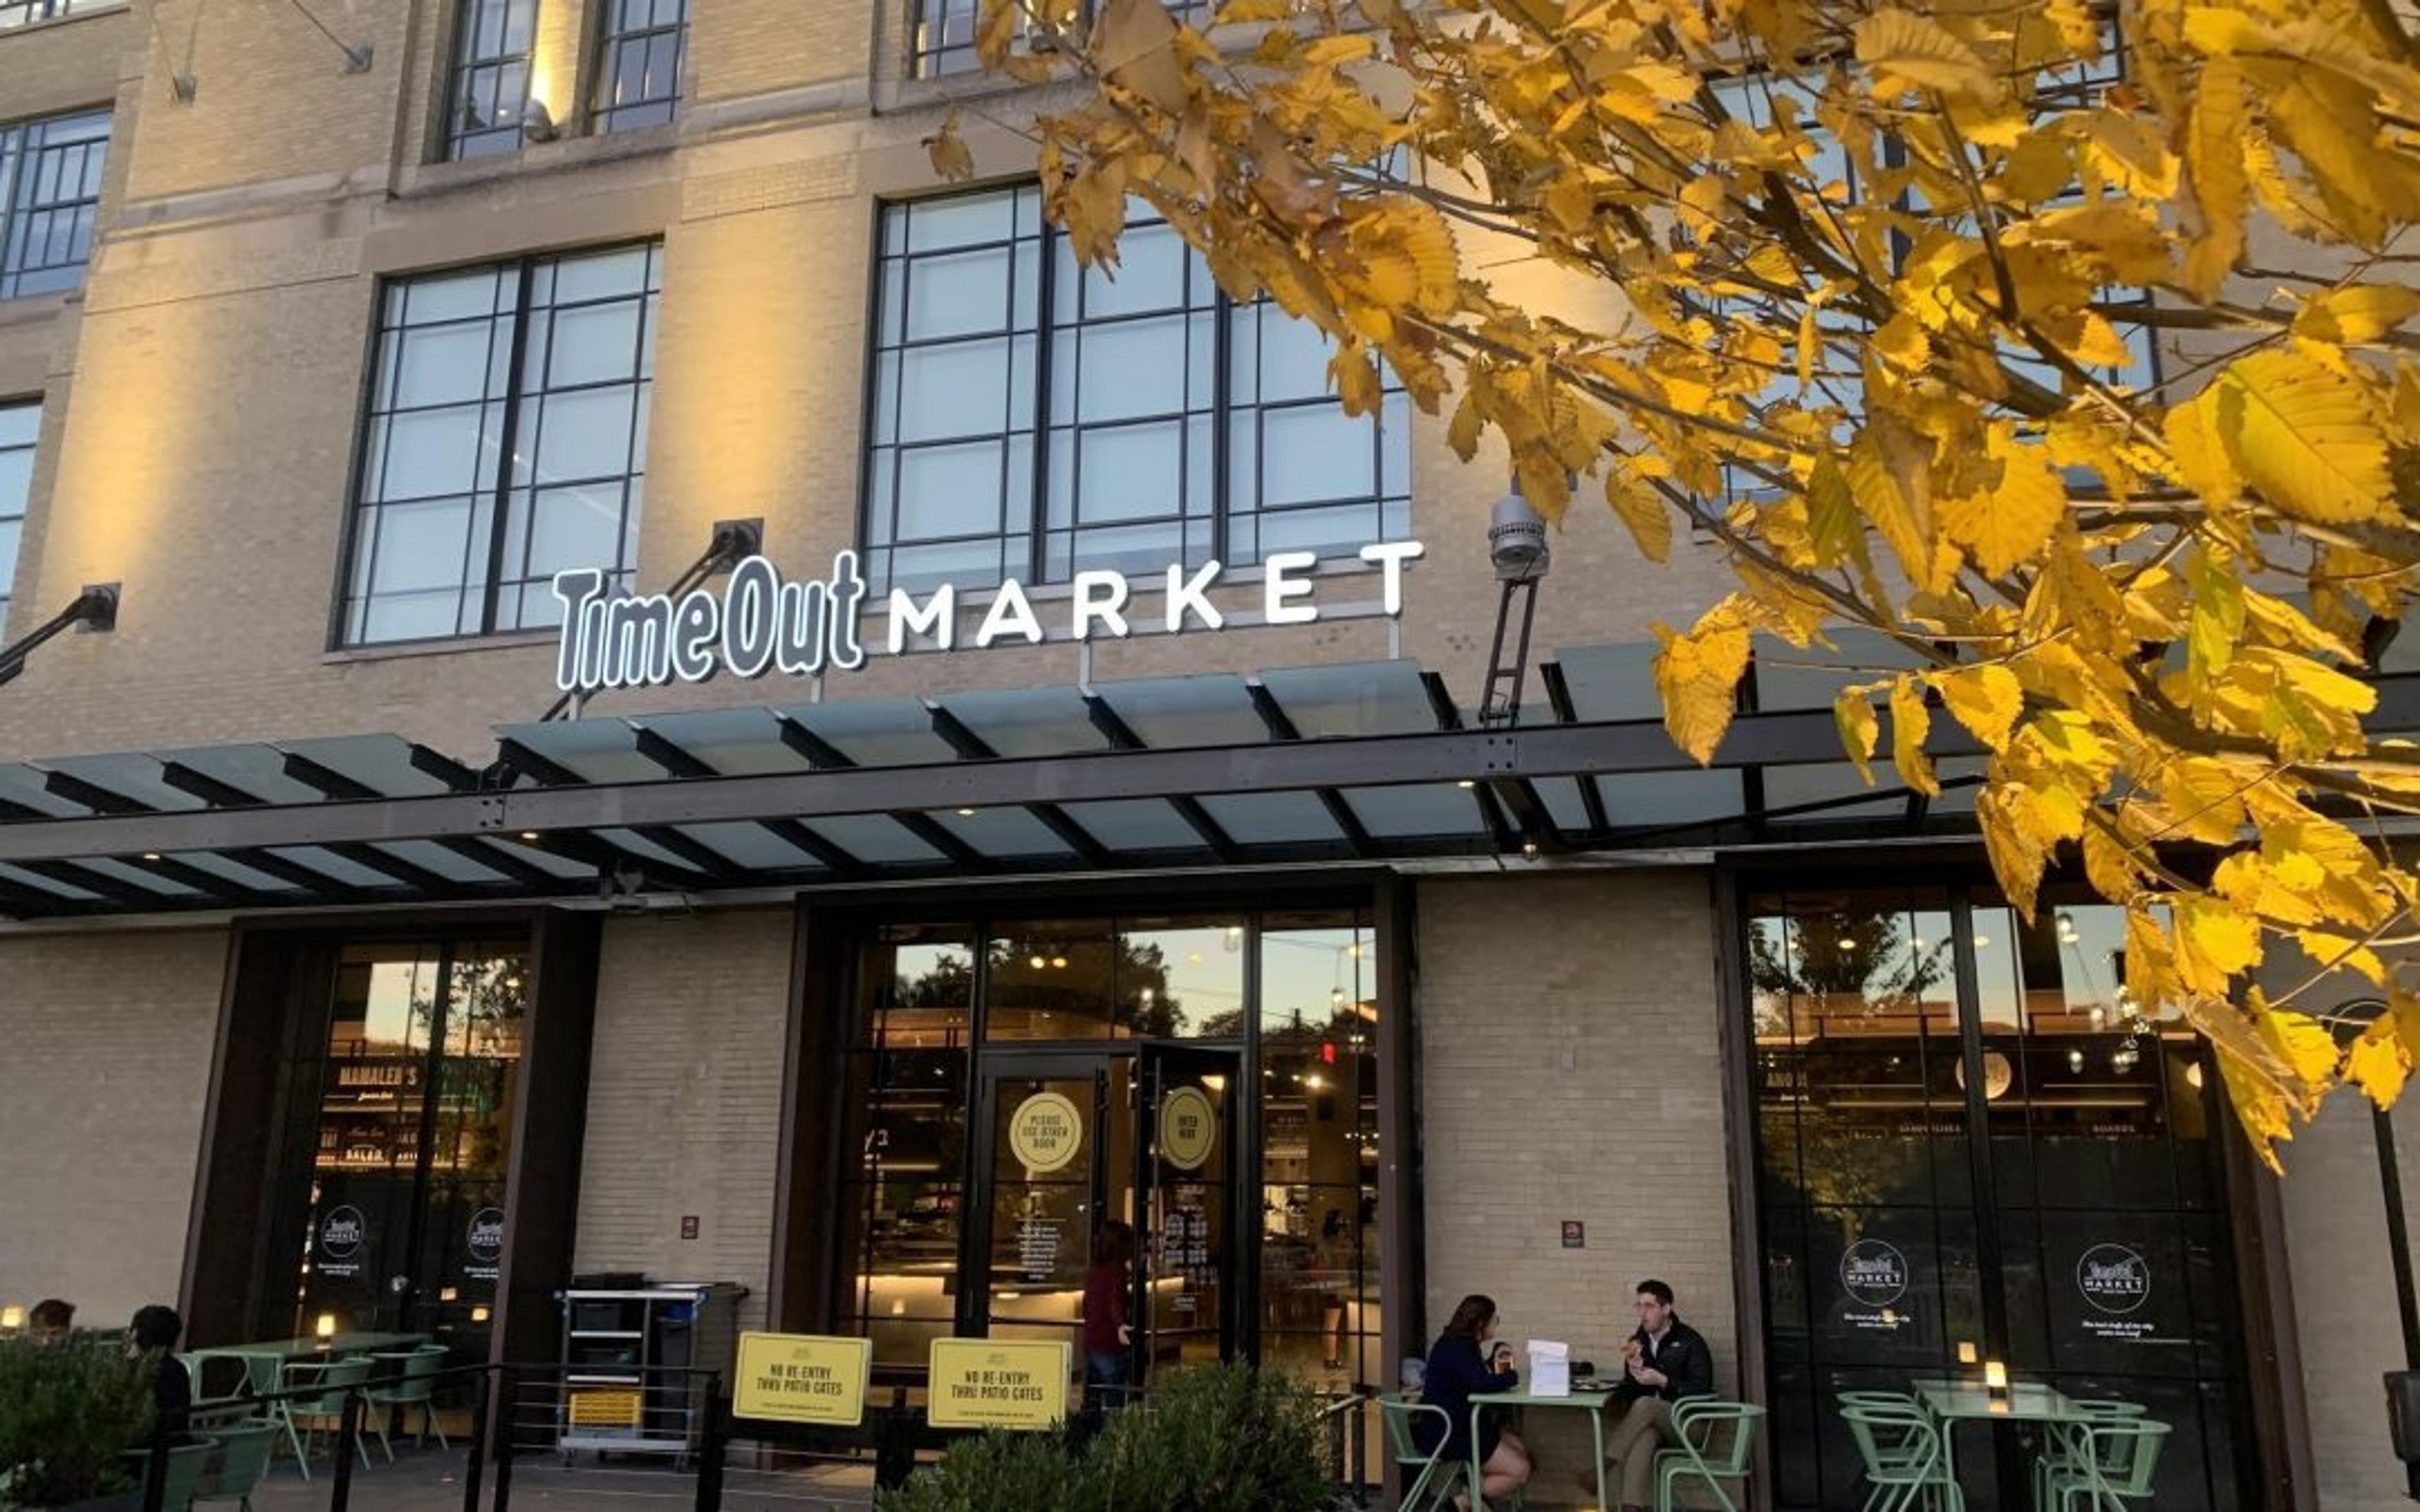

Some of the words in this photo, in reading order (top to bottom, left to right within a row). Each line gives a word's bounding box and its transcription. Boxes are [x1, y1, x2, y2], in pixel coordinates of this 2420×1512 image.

[888, 541, 1425, 655] MARKET
[1847, 1273, 1901, 1283] MARKET
[2083, 1280, 2143, 1290] MARKET
[770, 1364, 783, 1377] NO
[786, 1365, 832, 1380] RE-ENTRY
[965, 1370, 979, 1383] NO
[983, 1371, 1030, 1385] RE-ENTRY
[756, 1377, 781, 1392] THRU
[783, 1378, 810, 1394] PATIO
[814, 1381, 843, 1396] GATES
[951, 1385, 978, 1399] THRU
[981, 1386, 1009, 1400] PATIO
[1012, 1387, 1044, 1401] GATES
